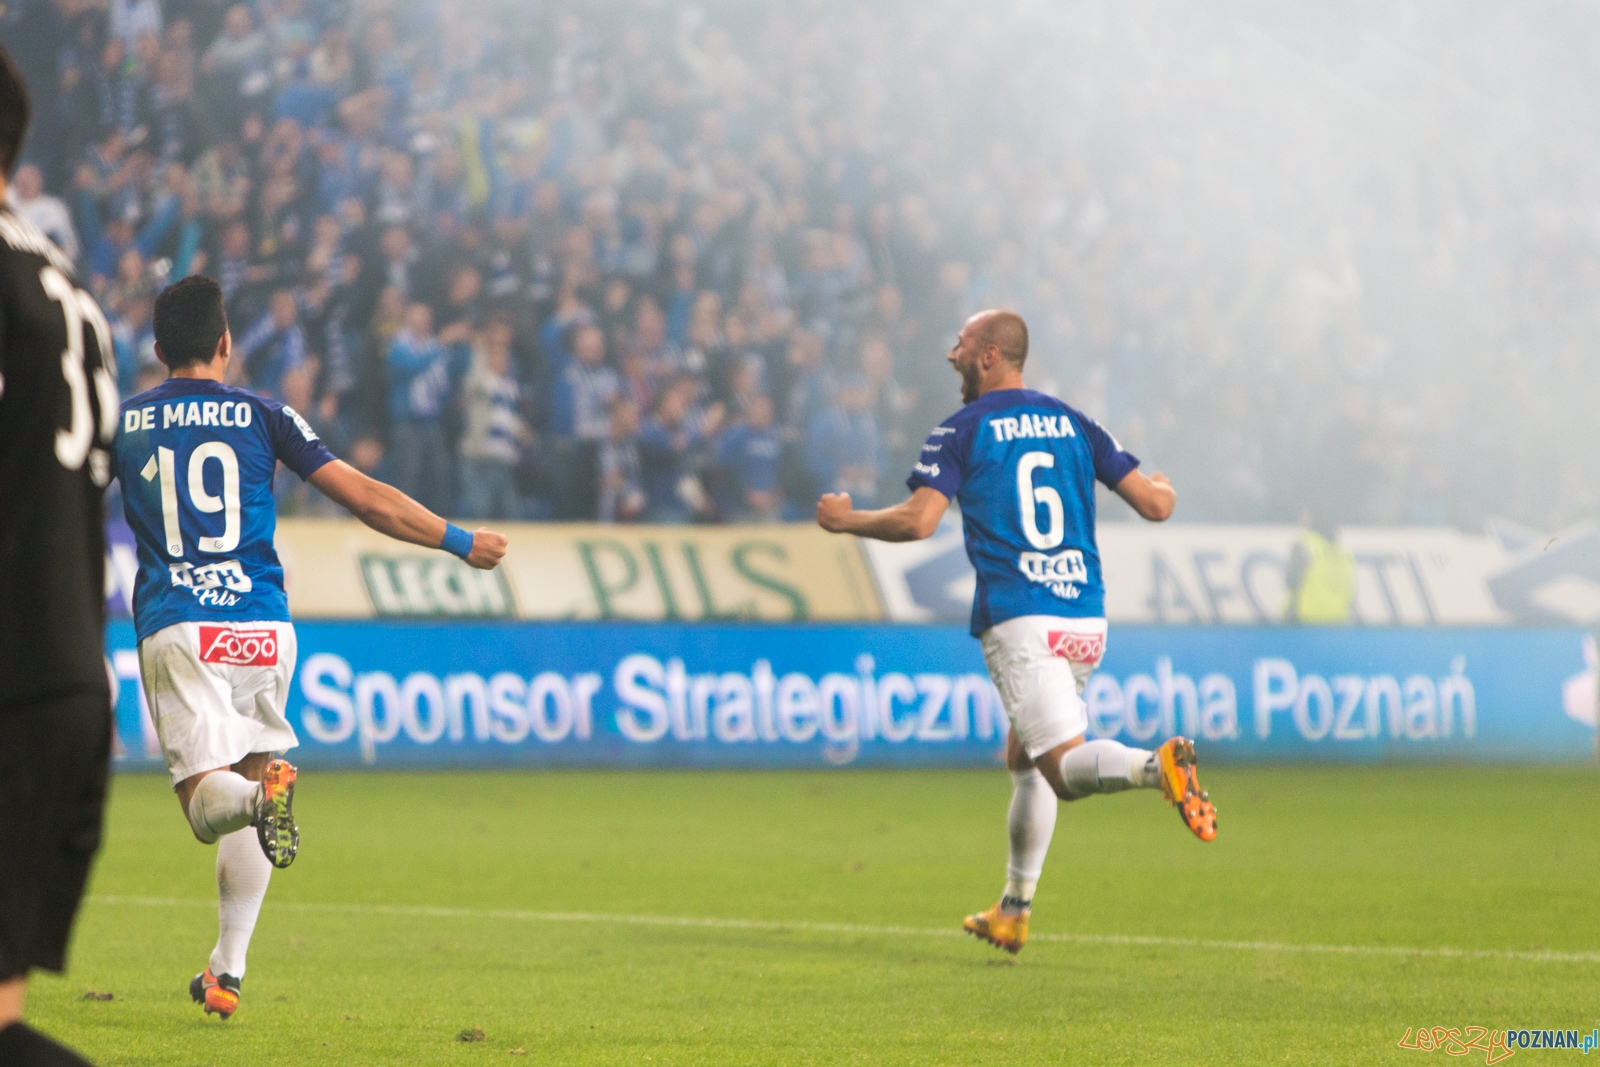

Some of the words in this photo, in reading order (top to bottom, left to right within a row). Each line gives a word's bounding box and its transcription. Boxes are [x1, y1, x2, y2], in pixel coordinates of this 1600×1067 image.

[124, 408, 156, 434] DE
[163, 401, 252, 429] MARCO
[989, 413, 1076, 442] TRAŁKA
[140, 440, 241, 557] 19
[1016, 451, 1065, 550] 6
[574, 538, 811, 620] PILS
[300, 652, 601, 764] Sponsor
[1086, 655, 1239, 741] echa
[1254, 654, 1477, 741] Poznań
